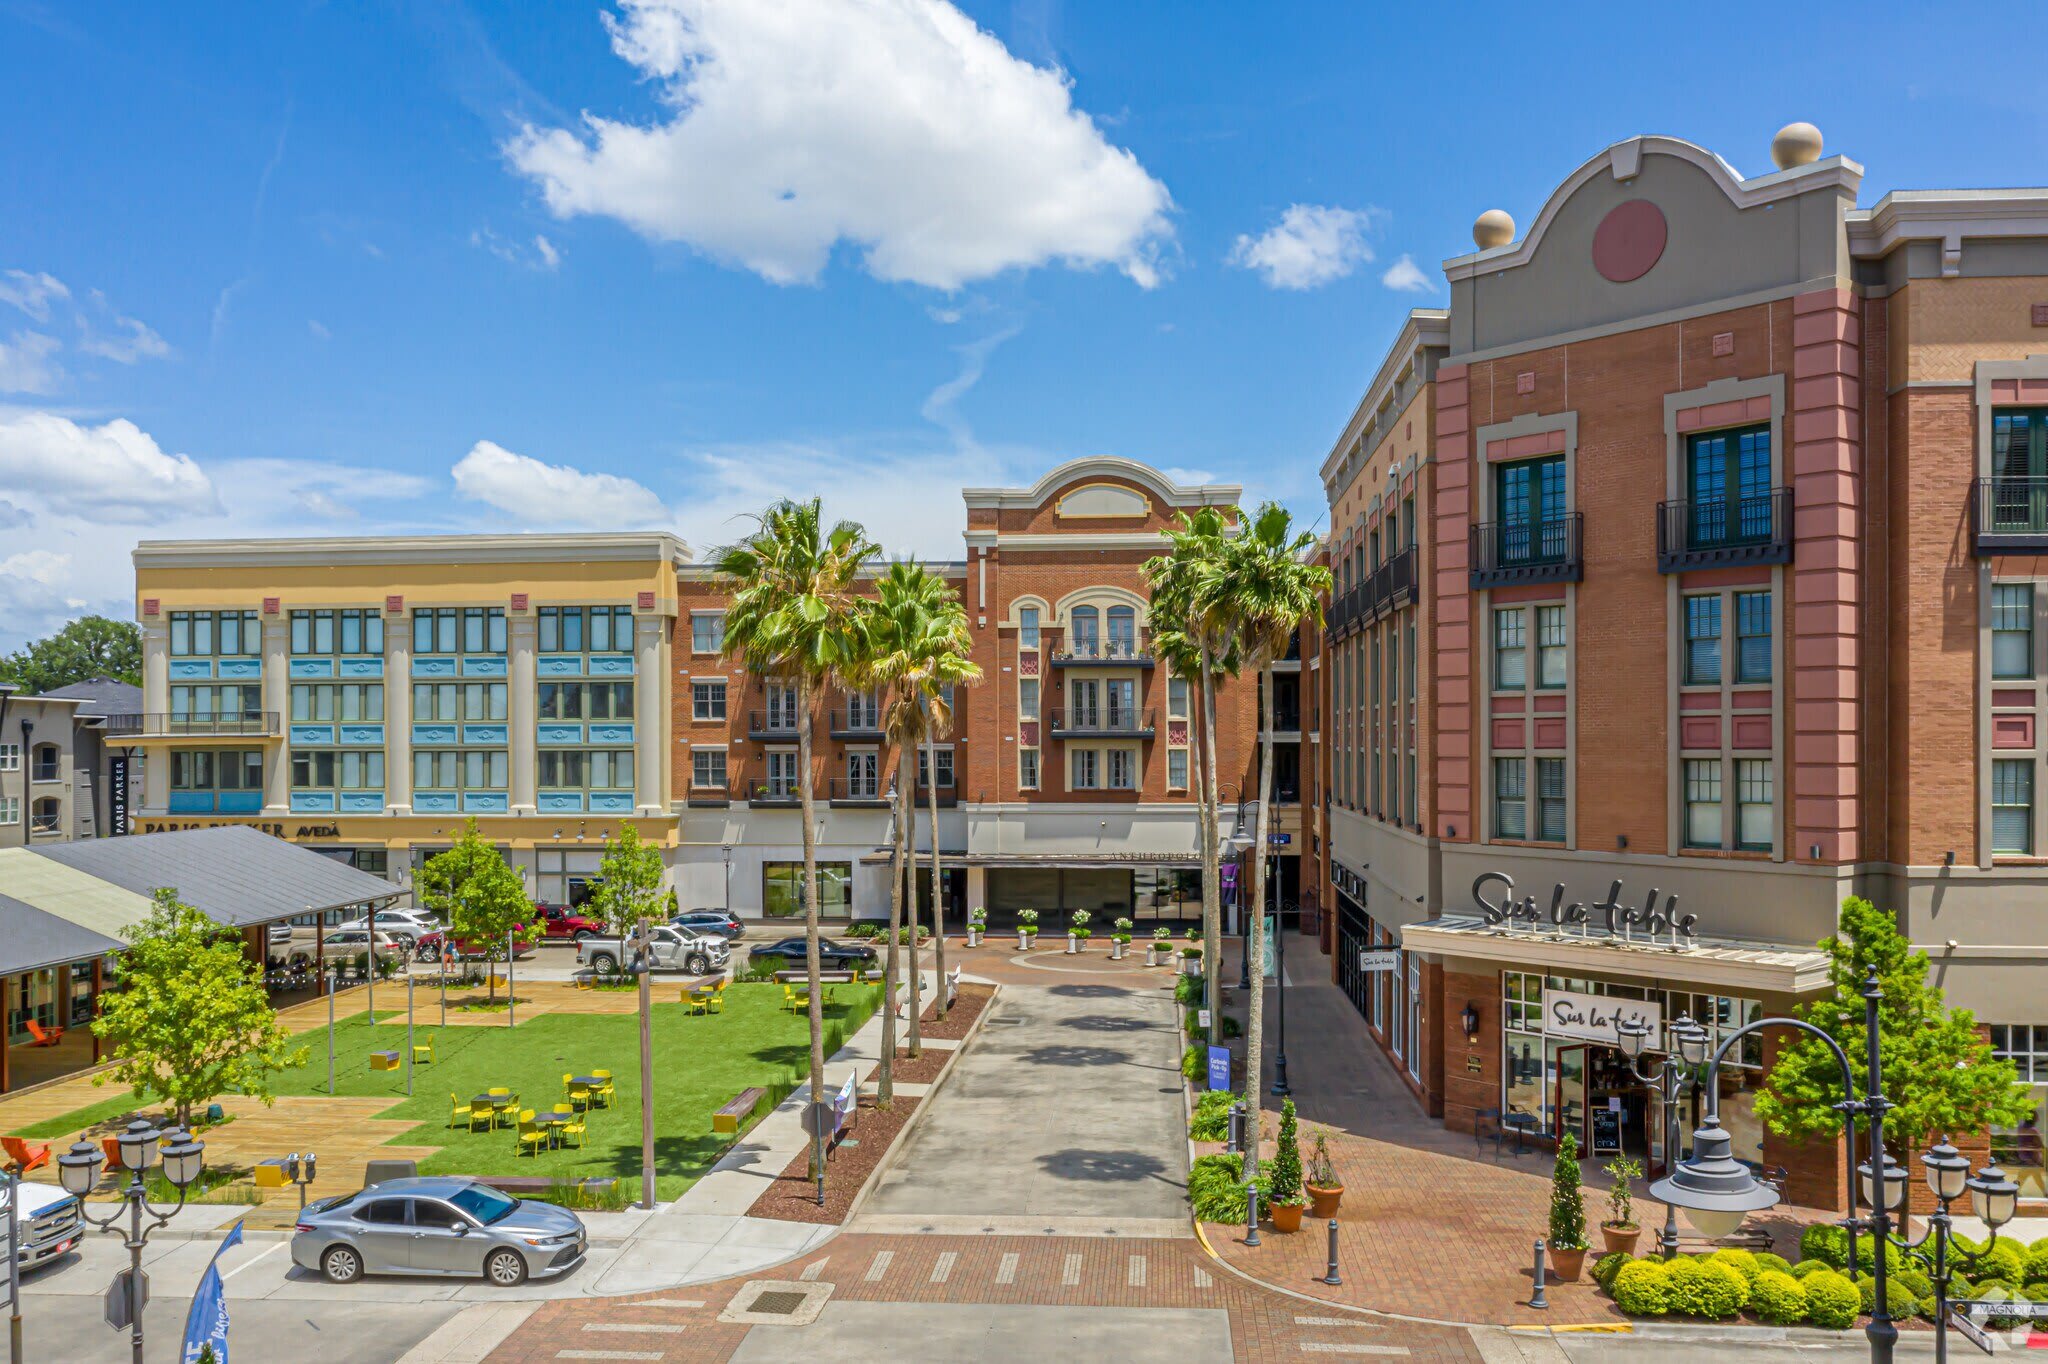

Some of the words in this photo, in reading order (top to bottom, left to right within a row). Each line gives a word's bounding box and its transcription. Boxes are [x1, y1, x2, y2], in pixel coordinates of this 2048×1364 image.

[115, 762, 124, 802] PARKER
[115, 805, 124, 834] PARIS
[296, 826, 340, 837] AVEDA
[1109, 852, 1227, 861] ANTHROPOLOE
[1472, 872, 1542, 925] Sur
[1551, 882, 1591, 926] la
[1592, 879, 1698, 937] table
[1381, 957, 1394, 965] table
[1553, 1000, 1585, 1026] Sur
[1590, 1007, 1607, 1027] la
[1609, 1007, 1654, 1036] tle
[1980, 1305, 2037, 1315] MAGNOLIA
